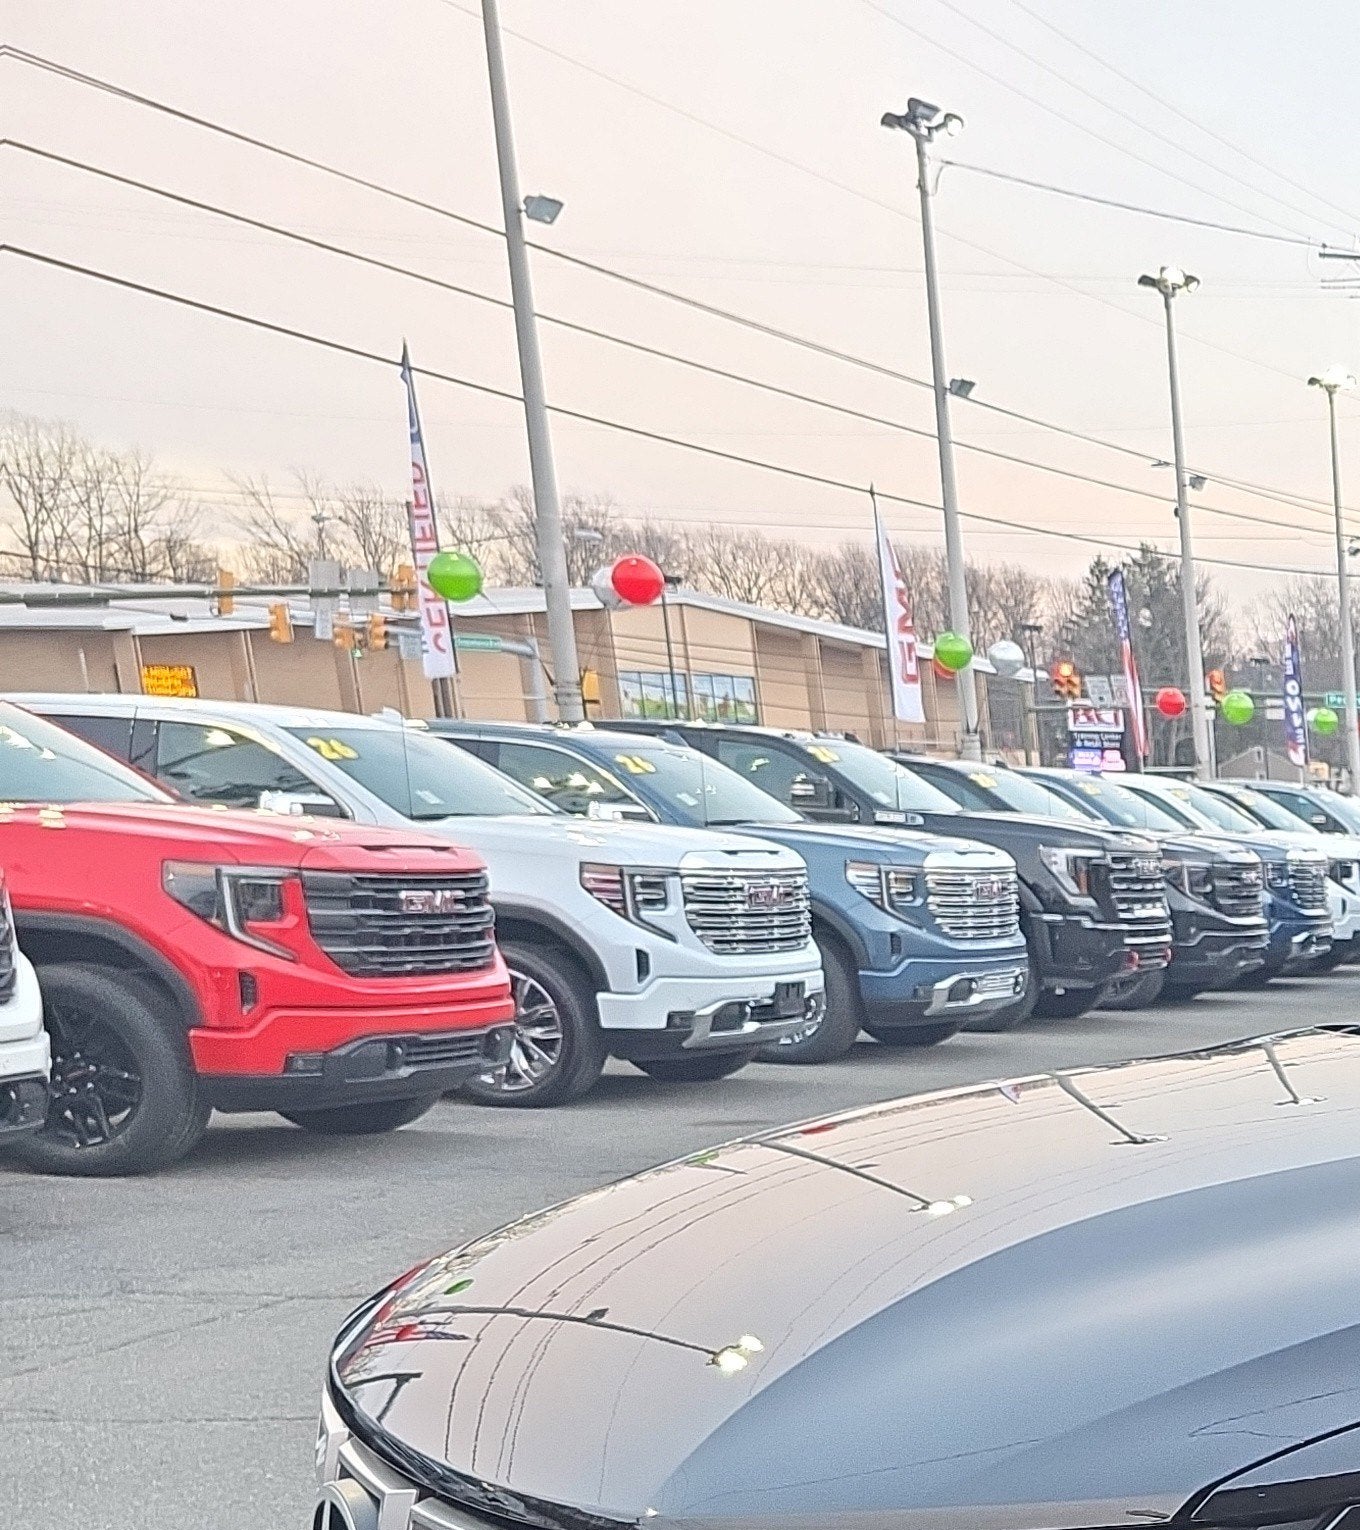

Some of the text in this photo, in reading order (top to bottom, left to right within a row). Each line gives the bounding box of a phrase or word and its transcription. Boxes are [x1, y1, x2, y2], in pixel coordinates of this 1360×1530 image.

[306, 736, 359, 760] 26
[614, 754, 657, 774] 26
[399, 889, 466, 914] GMC
[743, 884, 794, 910] GMC
